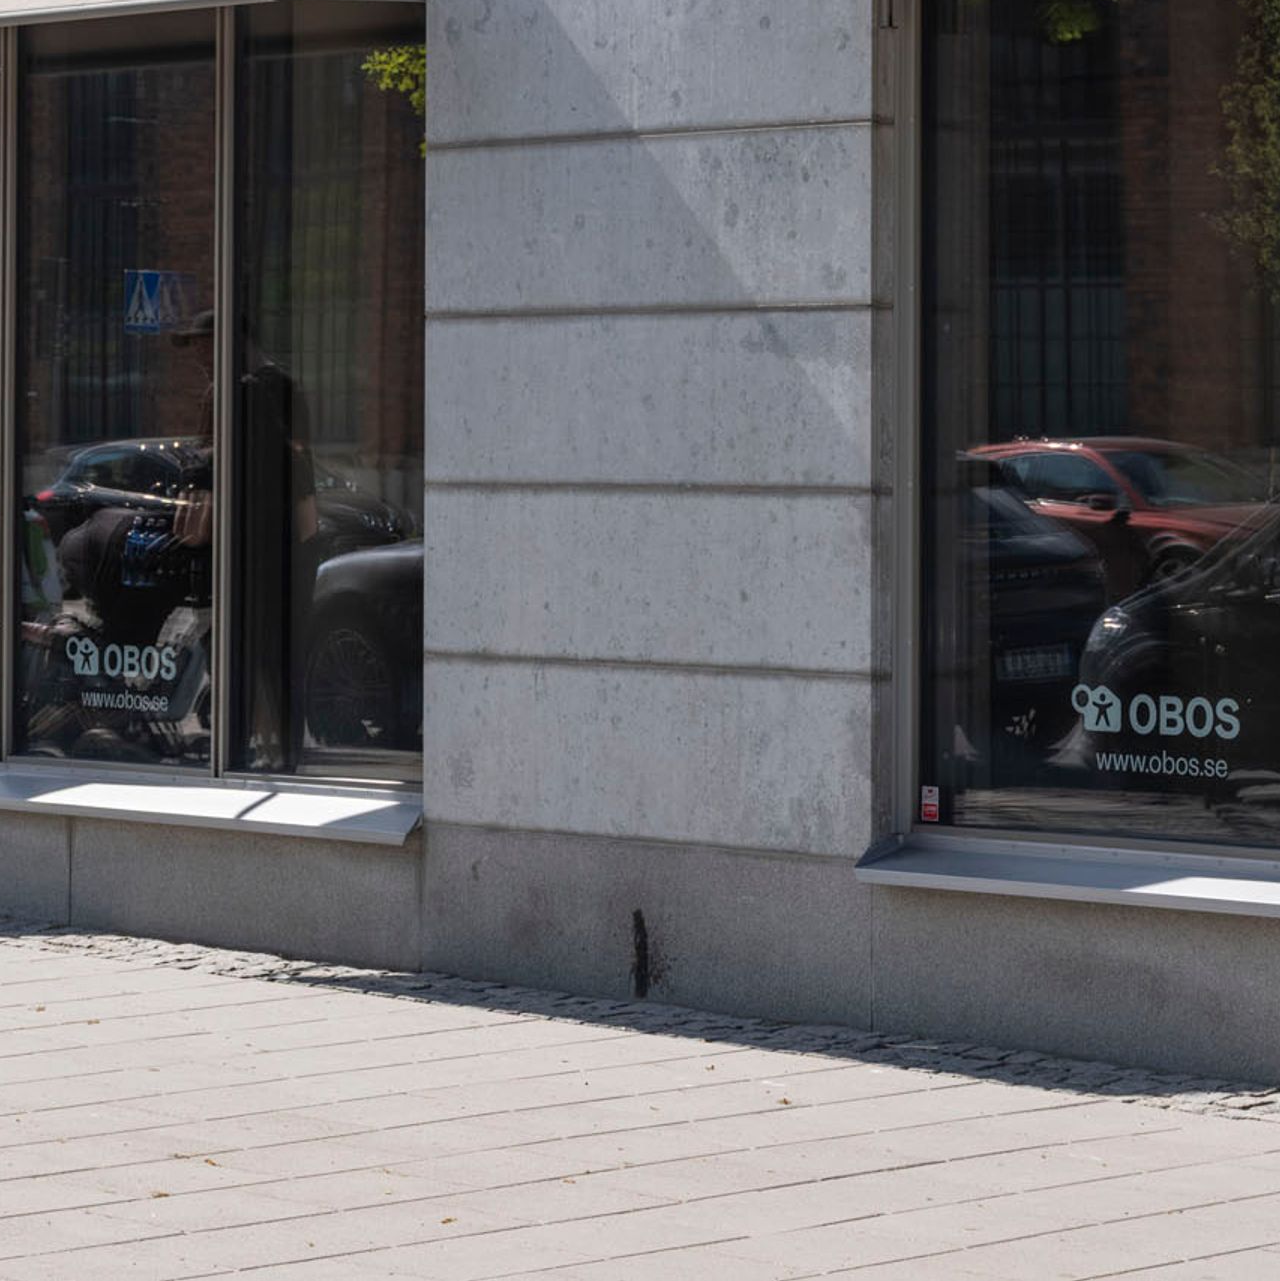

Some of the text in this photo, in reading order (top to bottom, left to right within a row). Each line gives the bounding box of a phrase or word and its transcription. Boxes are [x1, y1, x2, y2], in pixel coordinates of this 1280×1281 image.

[104, 643, 177, 681] OBOS
[81, 689, 169, 712] www.obos.se
[1129, 693, 1241, 739] OBOS
[1095, 749, 1228, 778] www.obos.se
